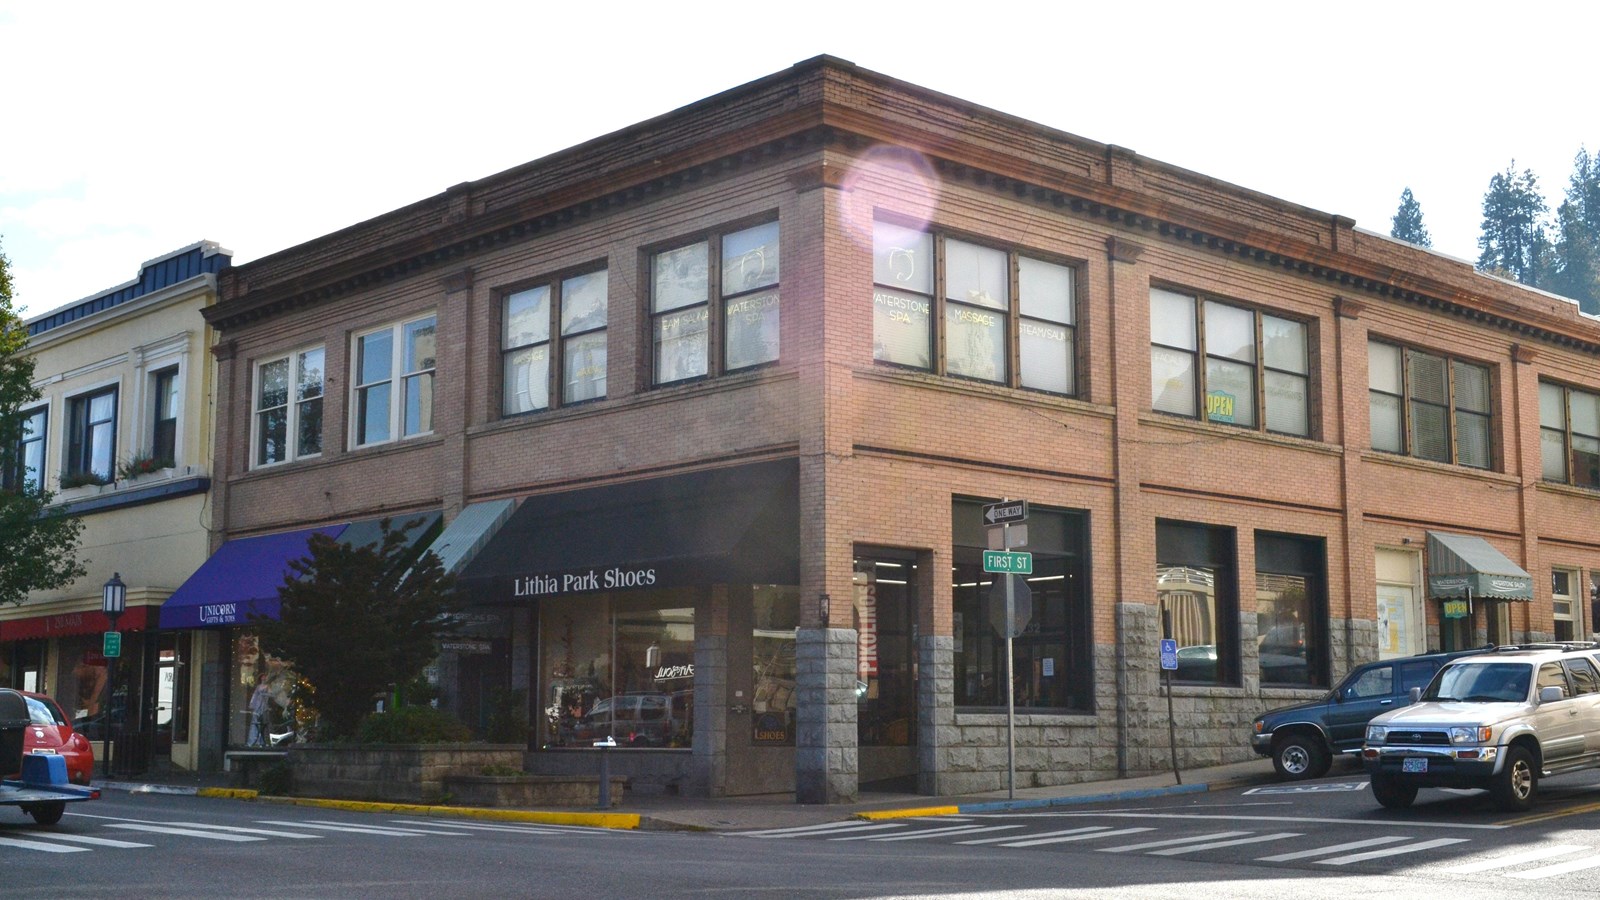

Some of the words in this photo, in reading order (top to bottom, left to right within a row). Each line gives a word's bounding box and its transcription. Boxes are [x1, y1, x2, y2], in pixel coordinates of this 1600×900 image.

[727, 294, 780, 315] WATERSTON
[889, 310, 911, 324] SPA
[954, 309, 995, 327] MASSAGE
[1206, 394, 1233, 416] OPEN
[993, 508, 1007, 518] ONE
[1007, 506, 1021, 516] WAY
[988, 555, 1012, 568] FIRST
[1017, 556, 1027, 569] ST
[514, 574, 558, 596] Lithia
[562, 570, 599, 592] Park
[604, 568, 656, 588] Shoes
[199, 603, 236, 621] UNICORN
[1446, 602, 1467, 614] OPEN
[858, 584, 877, 672] PIKOLINOS
